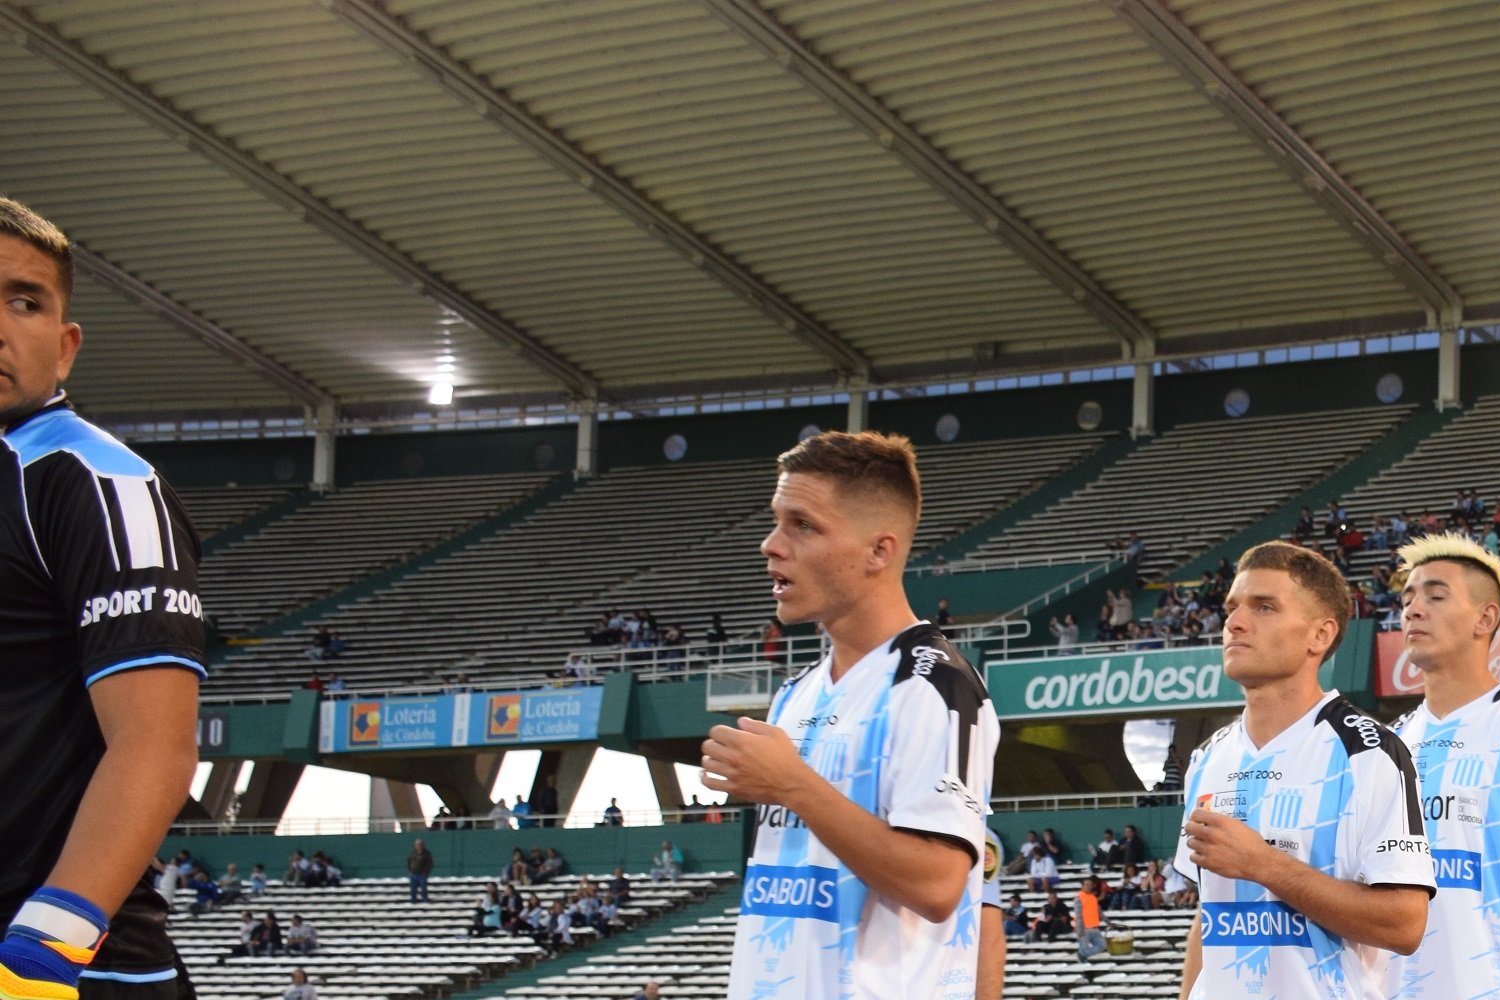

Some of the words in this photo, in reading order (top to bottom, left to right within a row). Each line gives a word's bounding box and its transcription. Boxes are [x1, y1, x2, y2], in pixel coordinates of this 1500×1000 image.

[81, 586, 156, 627] SPORT
[163, 588, 204, 622] 200
[1025, 650, 1220, 711] cordobesa
[1437, 739, 1465, 749] 2000
[1227, 770, 1255, 782] SPORT
[1255, 770, 1283, 781] 2000
[1420, 795, 1455, 822] cor
[1217, 911, 1306, 937] SABONIS
